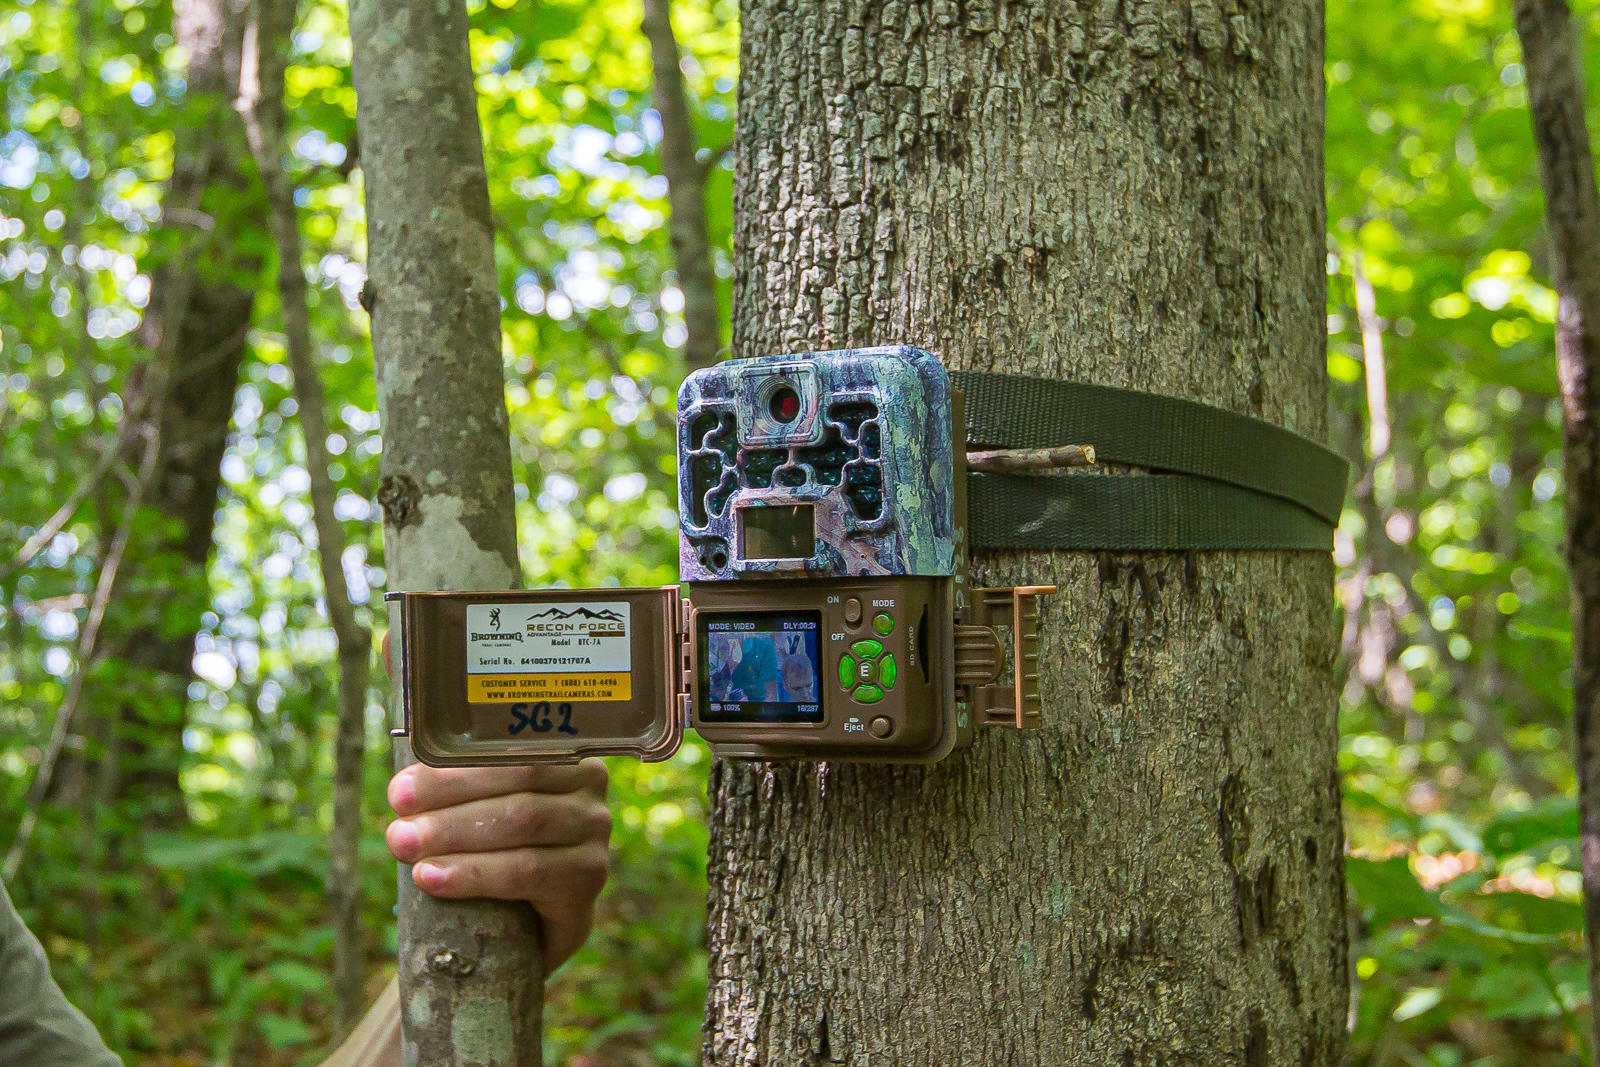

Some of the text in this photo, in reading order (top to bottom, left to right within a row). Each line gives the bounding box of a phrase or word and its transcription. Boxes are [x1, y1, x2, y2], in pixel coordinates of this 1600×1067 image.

[872, 599, 895, 607] MODE
[526, 623, 625, 632] RECON FORCE
[733, 622, 755, 630] VIDEO
[470, 632, 522, 642] BROWNING
[831, 633, 846, 641] OFF
[551, 638, 571, 646] Model
[479, 657, 501, 666] Serial
[860, 665, 869, 677] E
[843, 722, 865, 732] Eject
